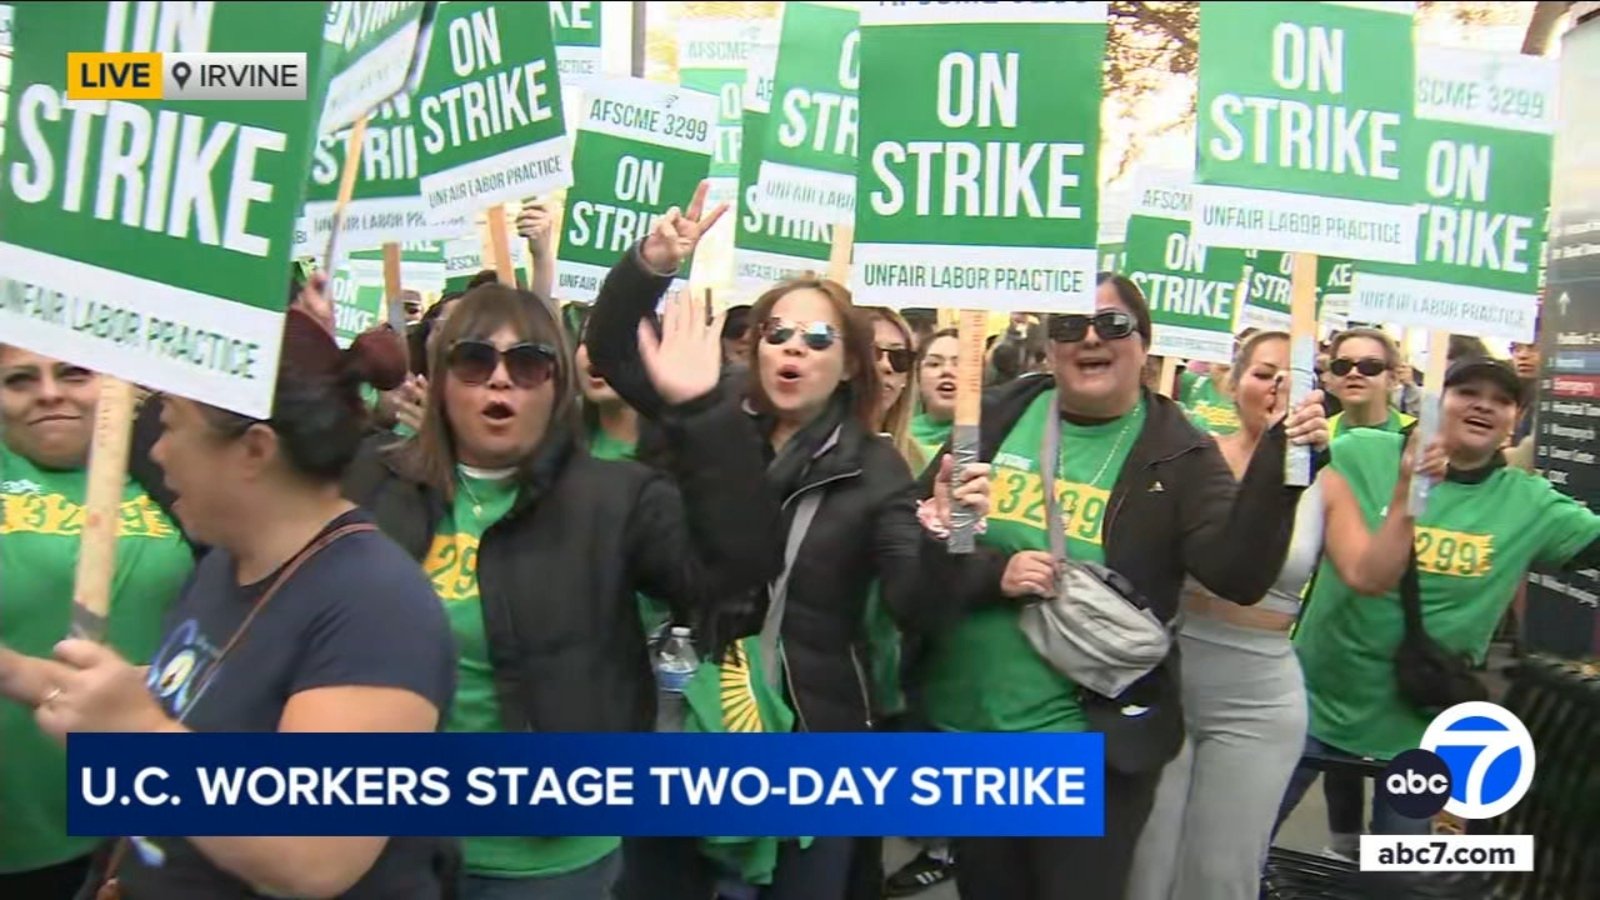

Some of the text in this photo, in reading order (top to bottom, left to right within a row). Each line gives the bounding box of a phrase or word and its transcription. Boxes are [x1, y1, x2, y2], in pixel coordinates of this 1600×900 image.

[448, 7, 502, 77] ON
[1271, 22, 1344, 94] ON
[420, 59, 553, 155] STRIKE
[937, 51, 1020, 129] ON
[1485, 87, 1546, 120] 3299
[589, 98, 708, 142] AFSCME 3299
[1210, 94, 1400, 182] STRIKE
[10, 83, 288, 258] STRIKE
[429, 154, 563, 209] UNFAIR LABOR PRACTICE
[614, 155, 664, 206] ON
[869, 140, 1085, 220] STRIKE
[1425, 139, 1491, 203] ON
[1165, 232, 1206, 274] ON
[1203, 205, 1401, 245] UNFAIR LABOR PRACTICE
[559, 273, 598, 293] UNFAIR
[864, 263, 1084, 293] UNFAIR LABOR PRACTICE
[72, 297, 142, 349] LABOR
[147, 315, 260, 379] PRACTICE
[1412, 296, 1459, 320] LABOR
[1460, 302, 1527, 328] PRACTICE
